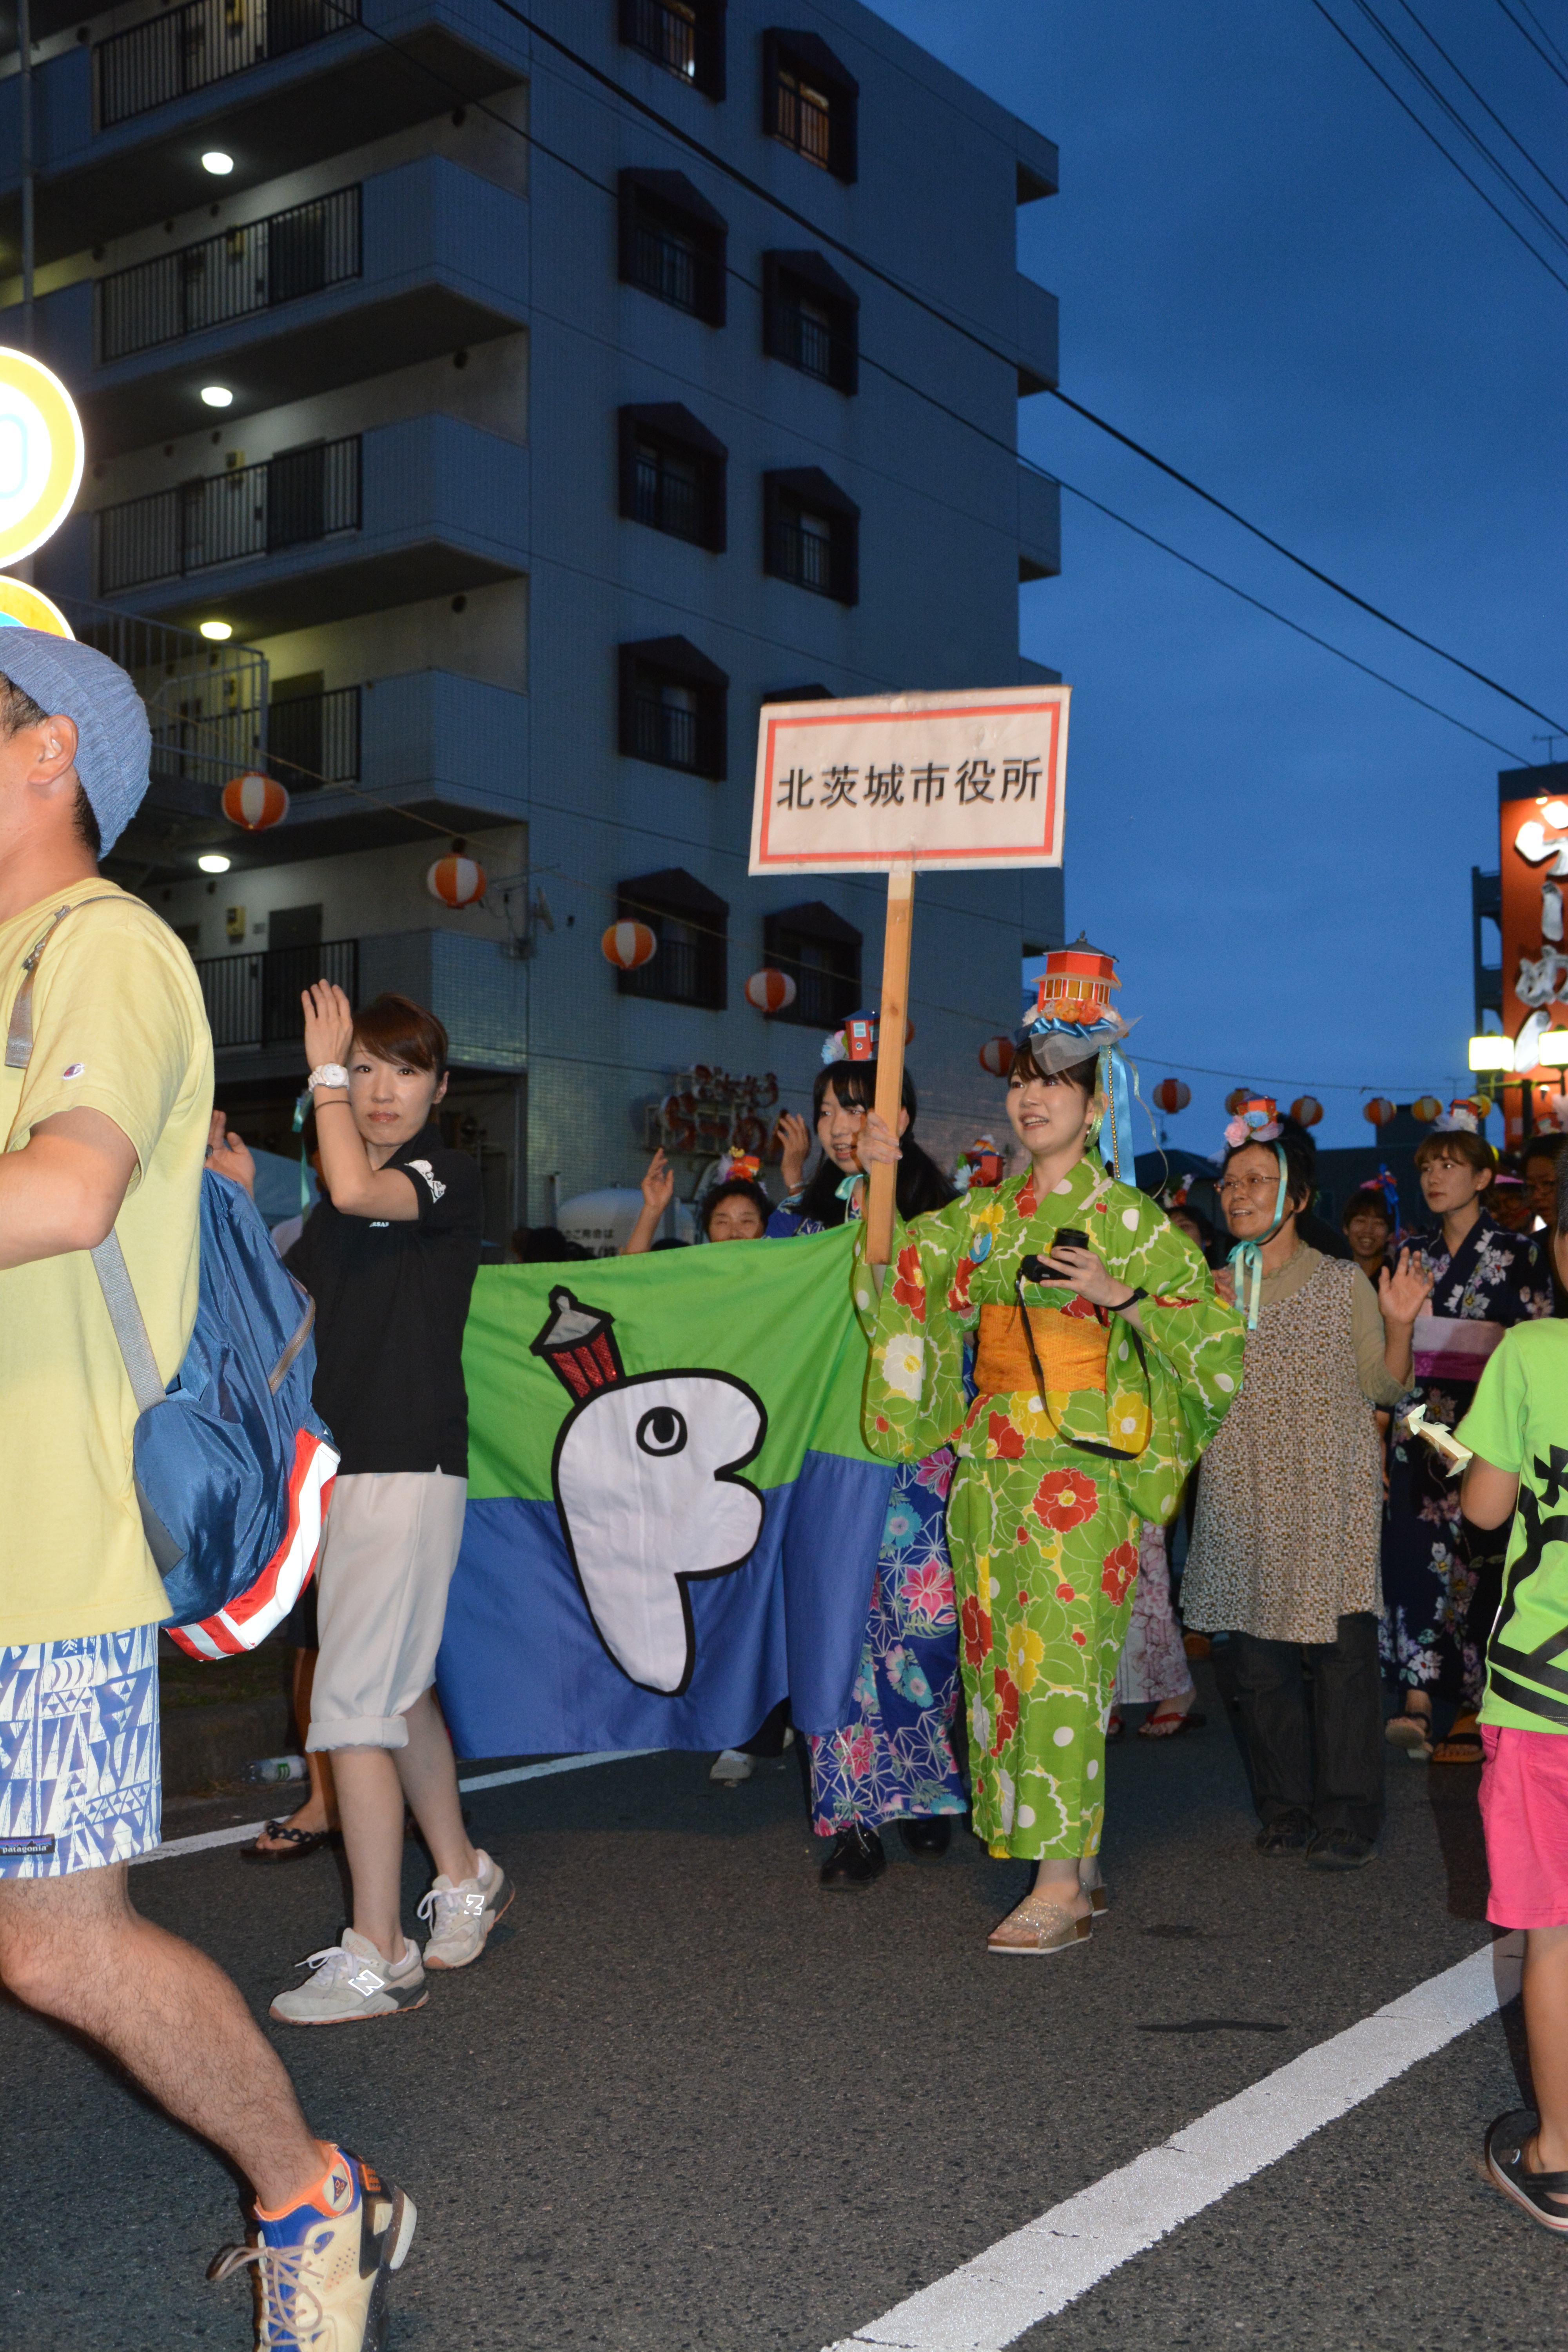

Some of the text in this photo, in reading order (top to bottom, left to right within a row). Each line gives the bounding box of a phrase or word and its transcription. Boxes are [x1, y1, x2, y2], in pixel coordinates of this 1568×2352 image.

[777, 756, 1044, 811] 北茨城市役所
[2, 1845, 47, 1854] patagonia
